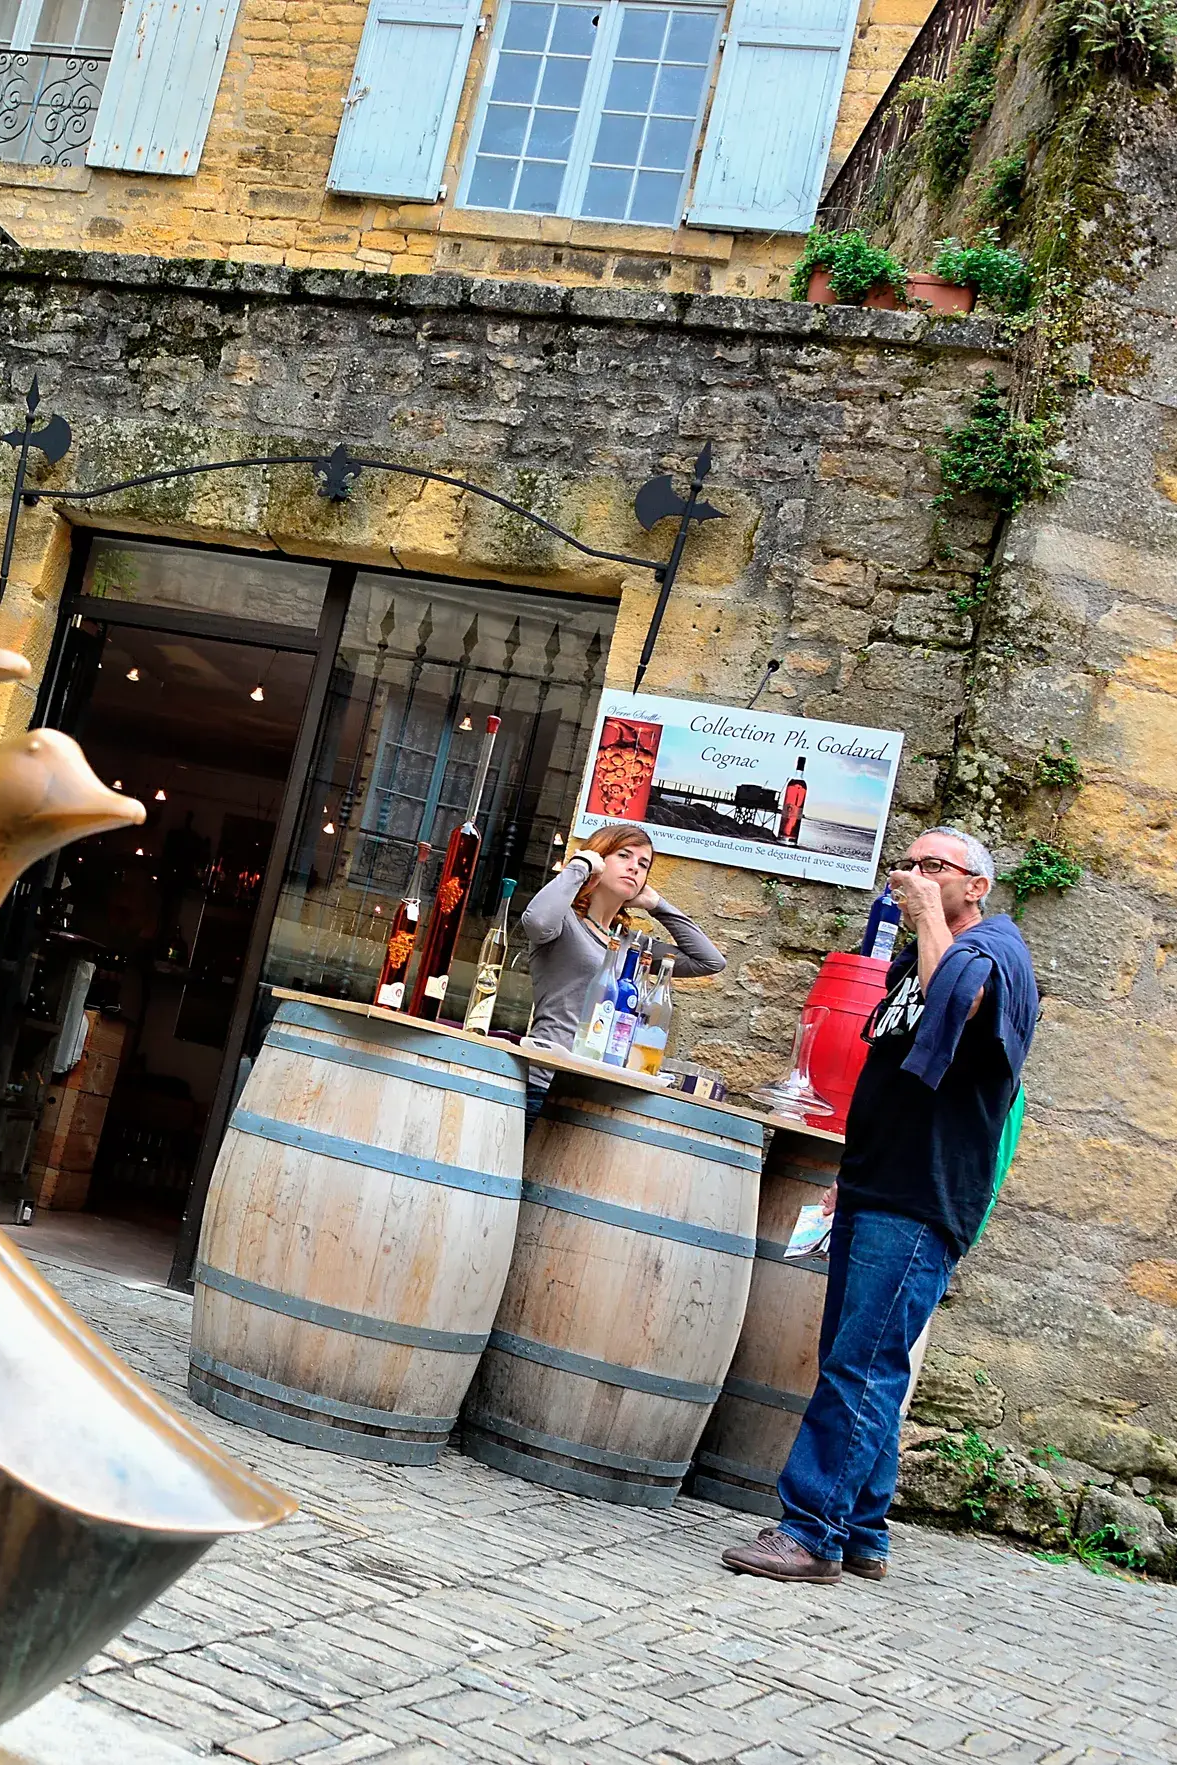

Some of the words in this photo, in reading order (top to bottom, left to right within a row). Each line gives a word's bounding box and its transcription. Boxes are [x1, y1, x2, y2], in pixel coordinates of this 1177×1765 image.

[607, 705, 631, 717] Verre
[690, 715, 775, 743] Collection
[784, 729, 809, 749] Ph.
[817, 735, 889, 760] Godard
[701, 747, 759, 769] Cognac
[581, 815, 598, 827] Les
[652, 829, 753, 853] www.cognacgodard.com
[755, 846, 766, 856] Se
[767, 848, 811, 863] dégustent
[813, 858, 834, 867] avec
[836, 863, 869, 873] sagesse
